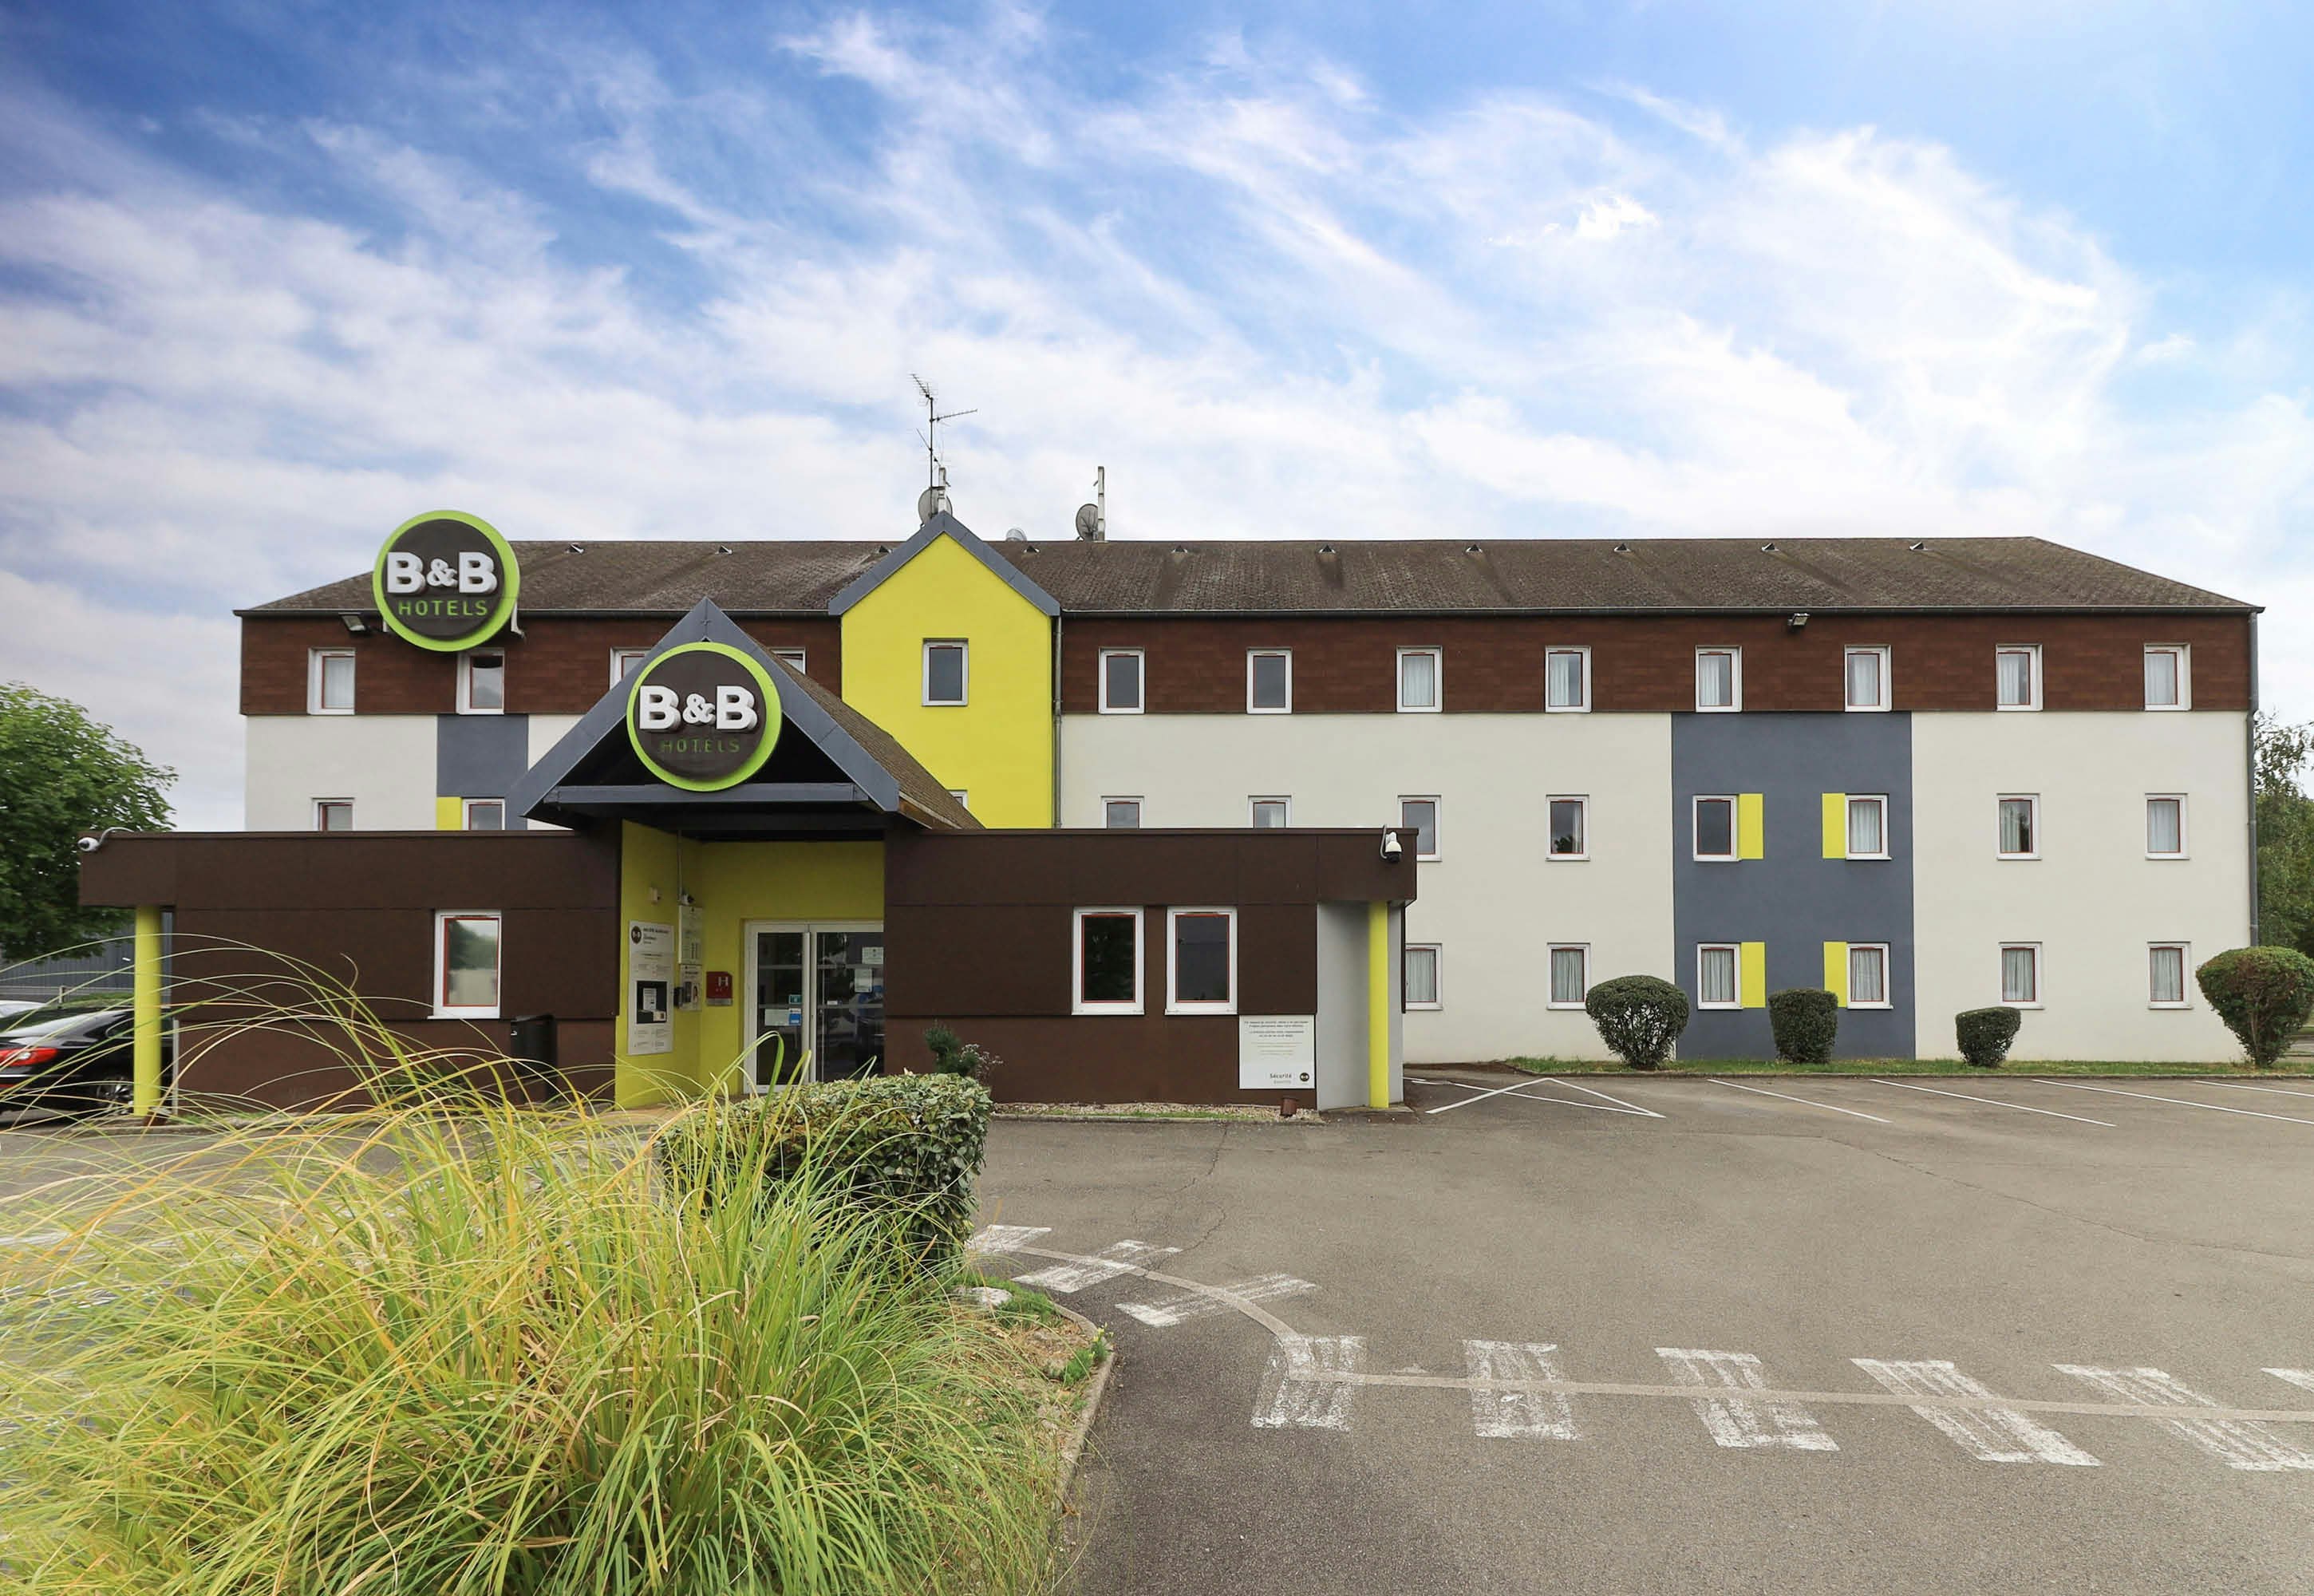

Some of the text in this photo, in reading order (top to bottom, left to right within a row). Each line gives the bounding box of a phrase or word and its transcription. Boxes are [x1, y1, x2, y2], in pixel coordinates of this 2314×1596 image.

[387, 551, 497, 594] B&B
[399, 600, 488, 616] HOTELS
[640, 685, 757, 730] B&B
[661, 738, 740, 753] HOTELS
